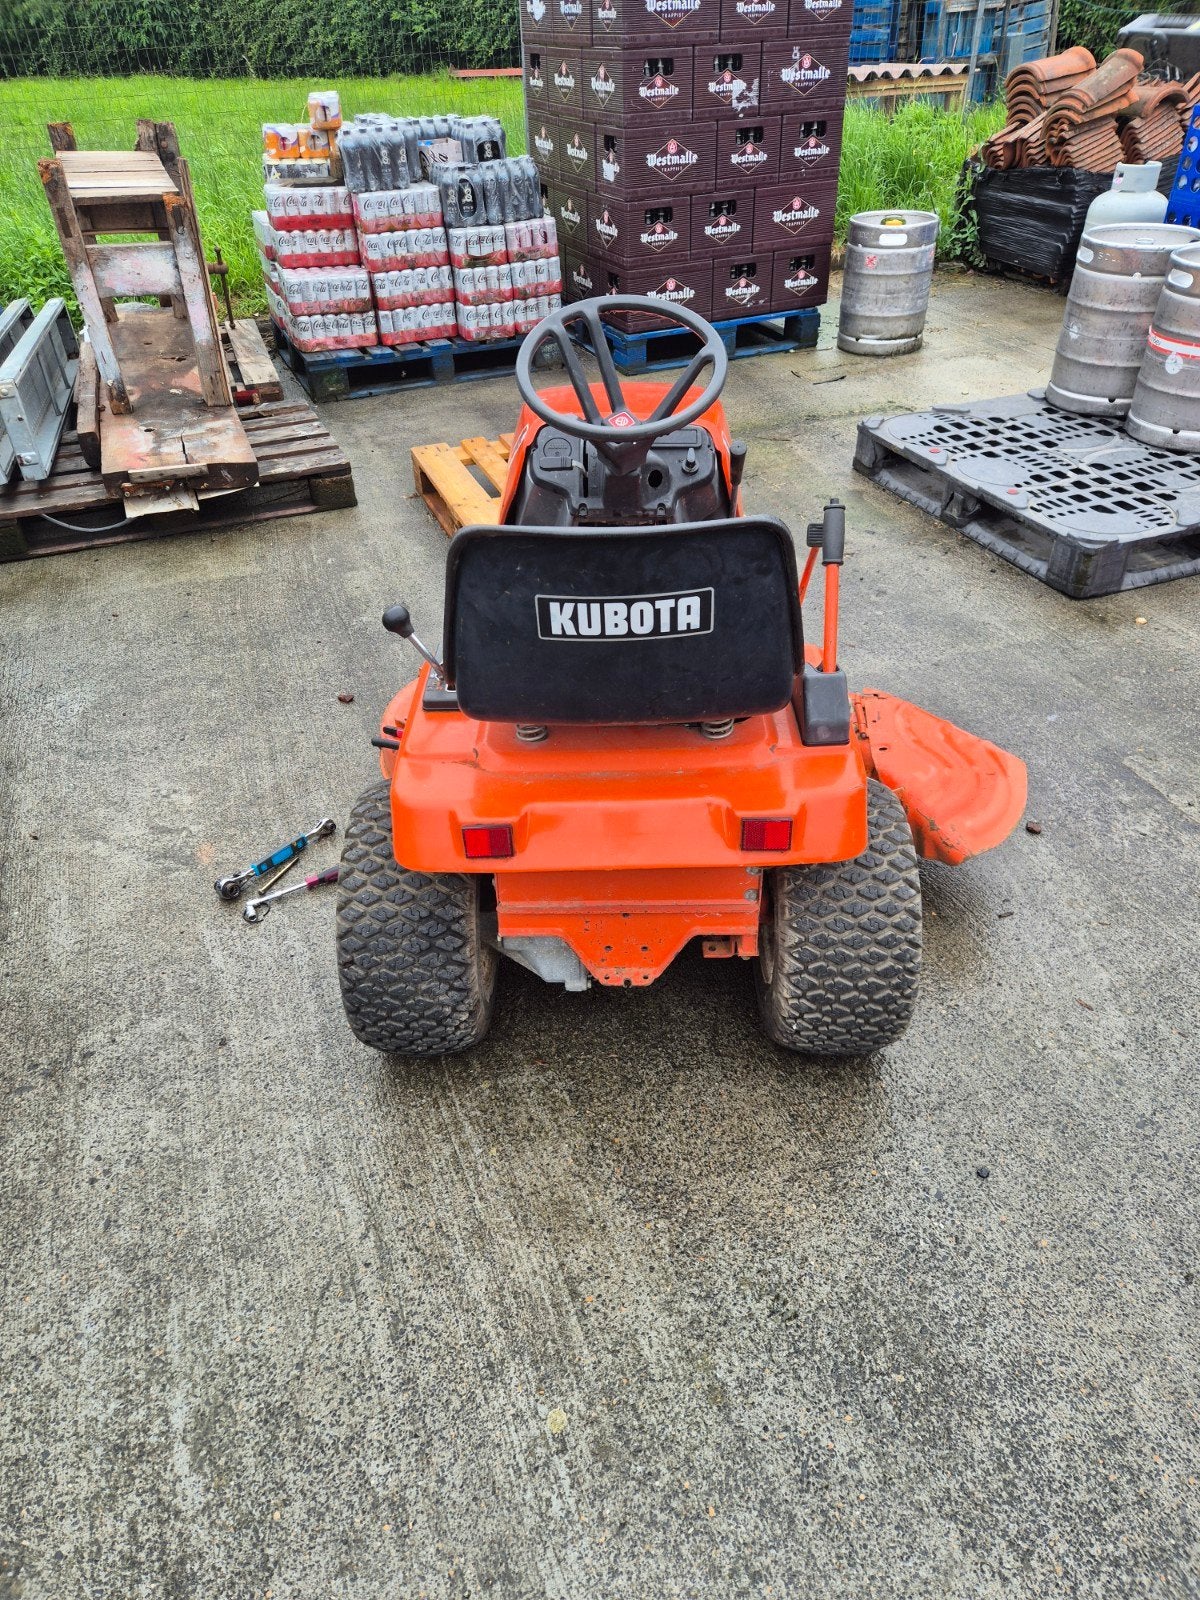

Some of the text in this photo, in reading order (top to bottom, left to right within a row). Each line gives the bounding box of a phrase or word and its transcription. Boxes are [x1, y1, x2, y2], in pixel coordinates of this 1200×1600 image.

[645, 0, 700, 11] Westmalle
[736, 2, 776, 13] Westmalle
[804, 0, 842, 9] Westmalle
[781, 66, 830, 83] Westmalle
[639, 84, 680, 98] Westmalle
[794, 145, 830, 158] Westmalle
[646, 153, 698, 168] Westmalle
[730, 152, 768, 164] Westmalle
[772, 206, 820, 222] Westmalle
[704, 223, 741, 235] Westmalle
[640, 230, 678, 243] Westmalle
[784, 276, 818, 288] Westmalle
[725, 285, 760, 297] Westmalle
[550, 596, 700, 636] KUBOTA
